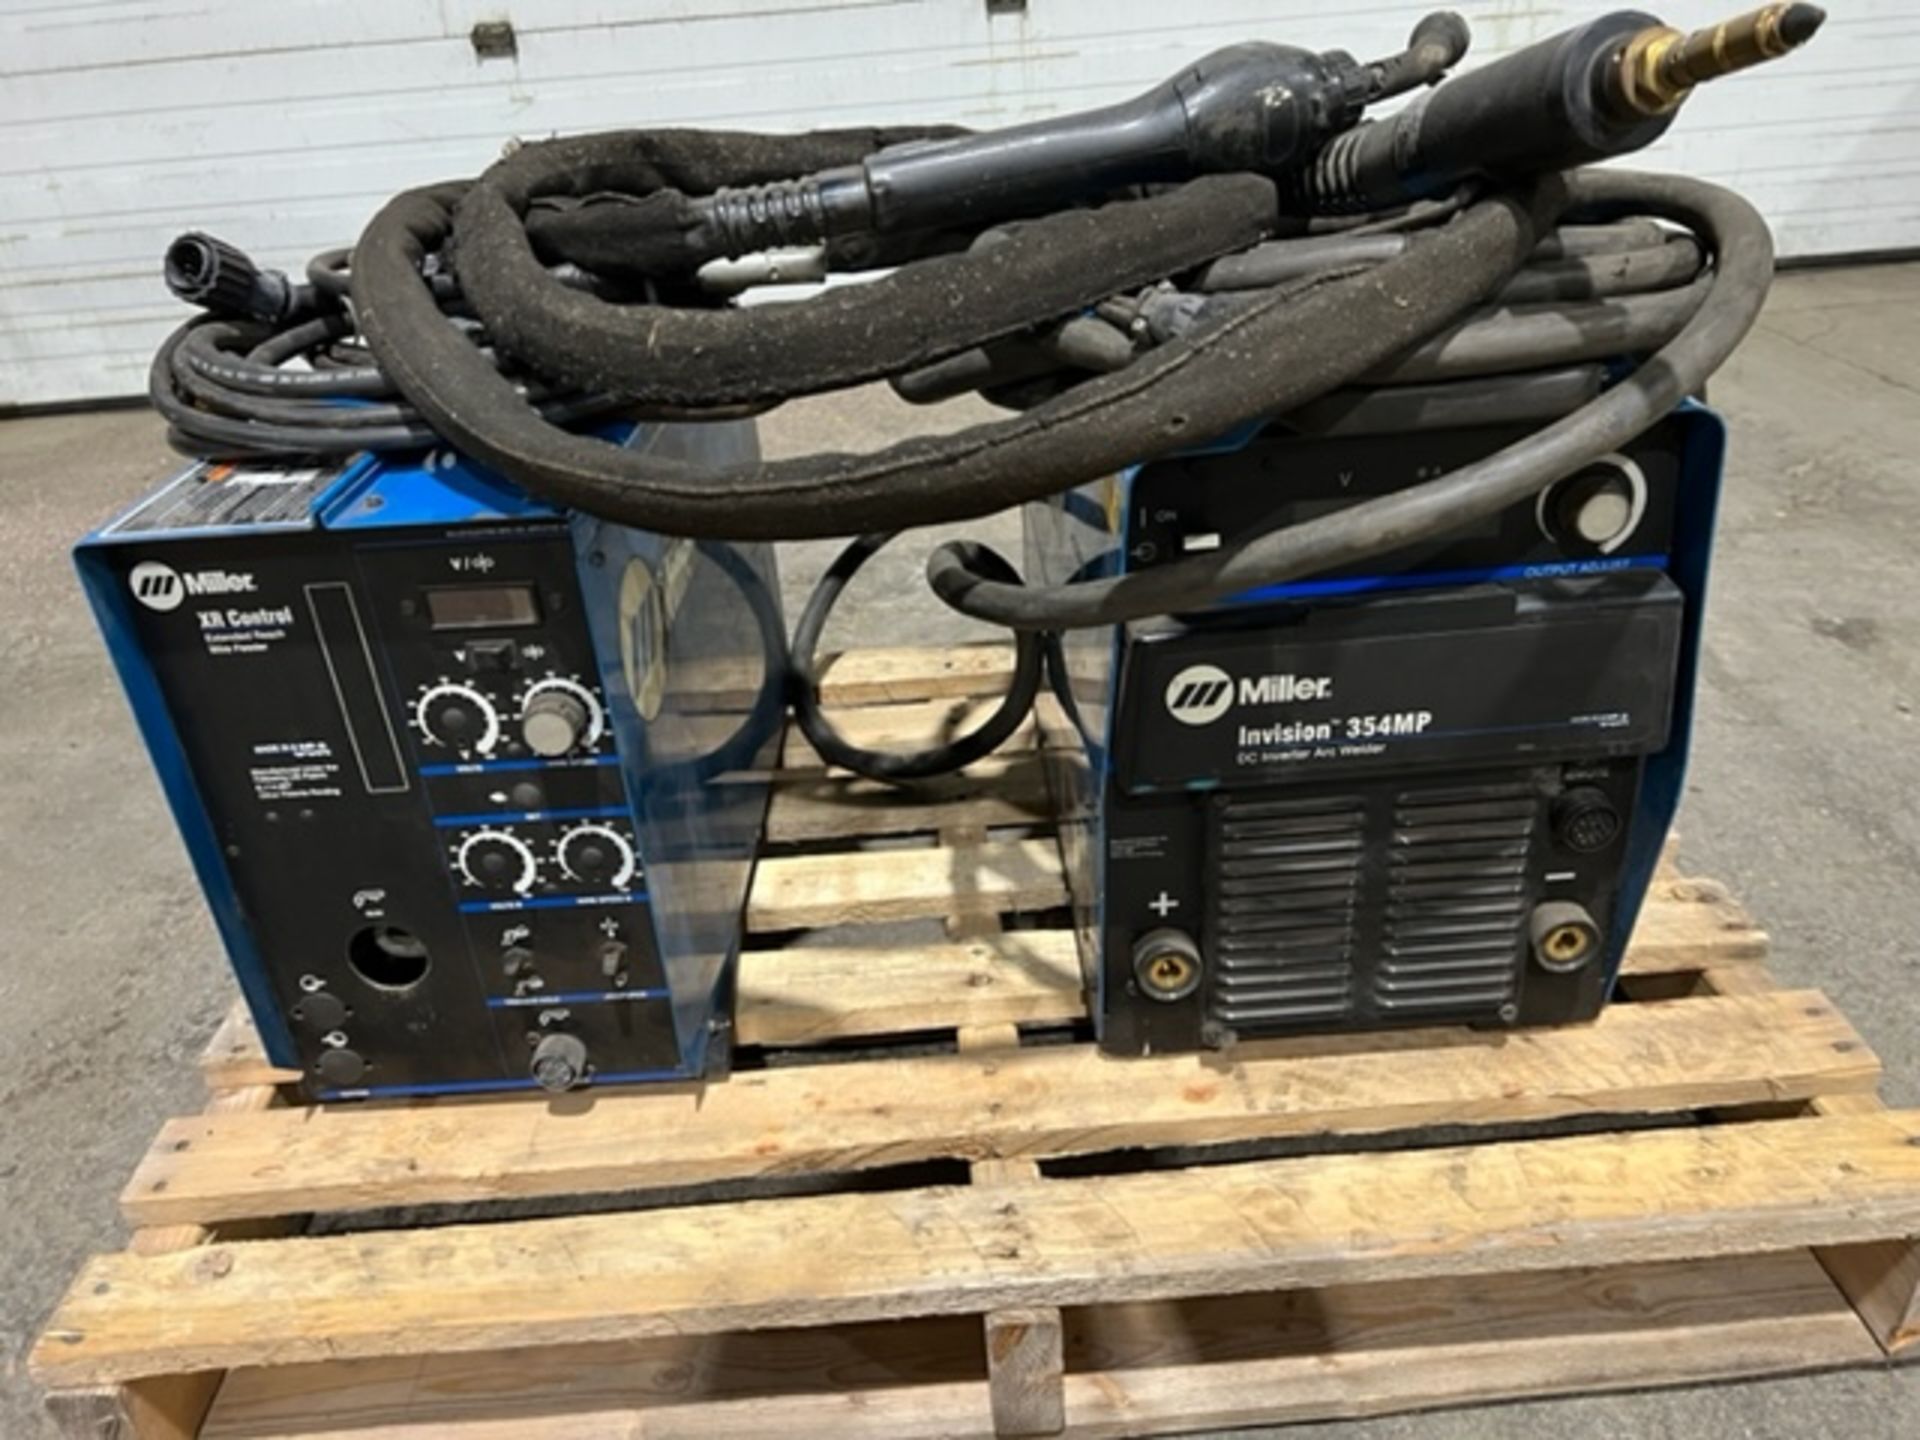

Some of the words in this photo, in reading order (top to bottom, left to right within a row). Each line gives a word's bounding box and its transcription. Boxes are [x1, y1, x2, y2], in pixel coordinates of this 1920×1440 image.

[1339, 471, 1353, 487] V
[1523, 561, 1578, 579] OUTPUT
[183, 570, 256, 595] Miller
[196, 611, 226, 629] XR
[227, 605, 293, 626] Control
[1239, 674, 1331, 705] Miller
[1346, 711, 1432, 738] 354MP
[1237, 751, 1258, 765] DC
[1261, 749, 1311, 762] Inverter
[1313, 746, 1336, 758] Arc
[1340, 743, 1387, 756] Welder
